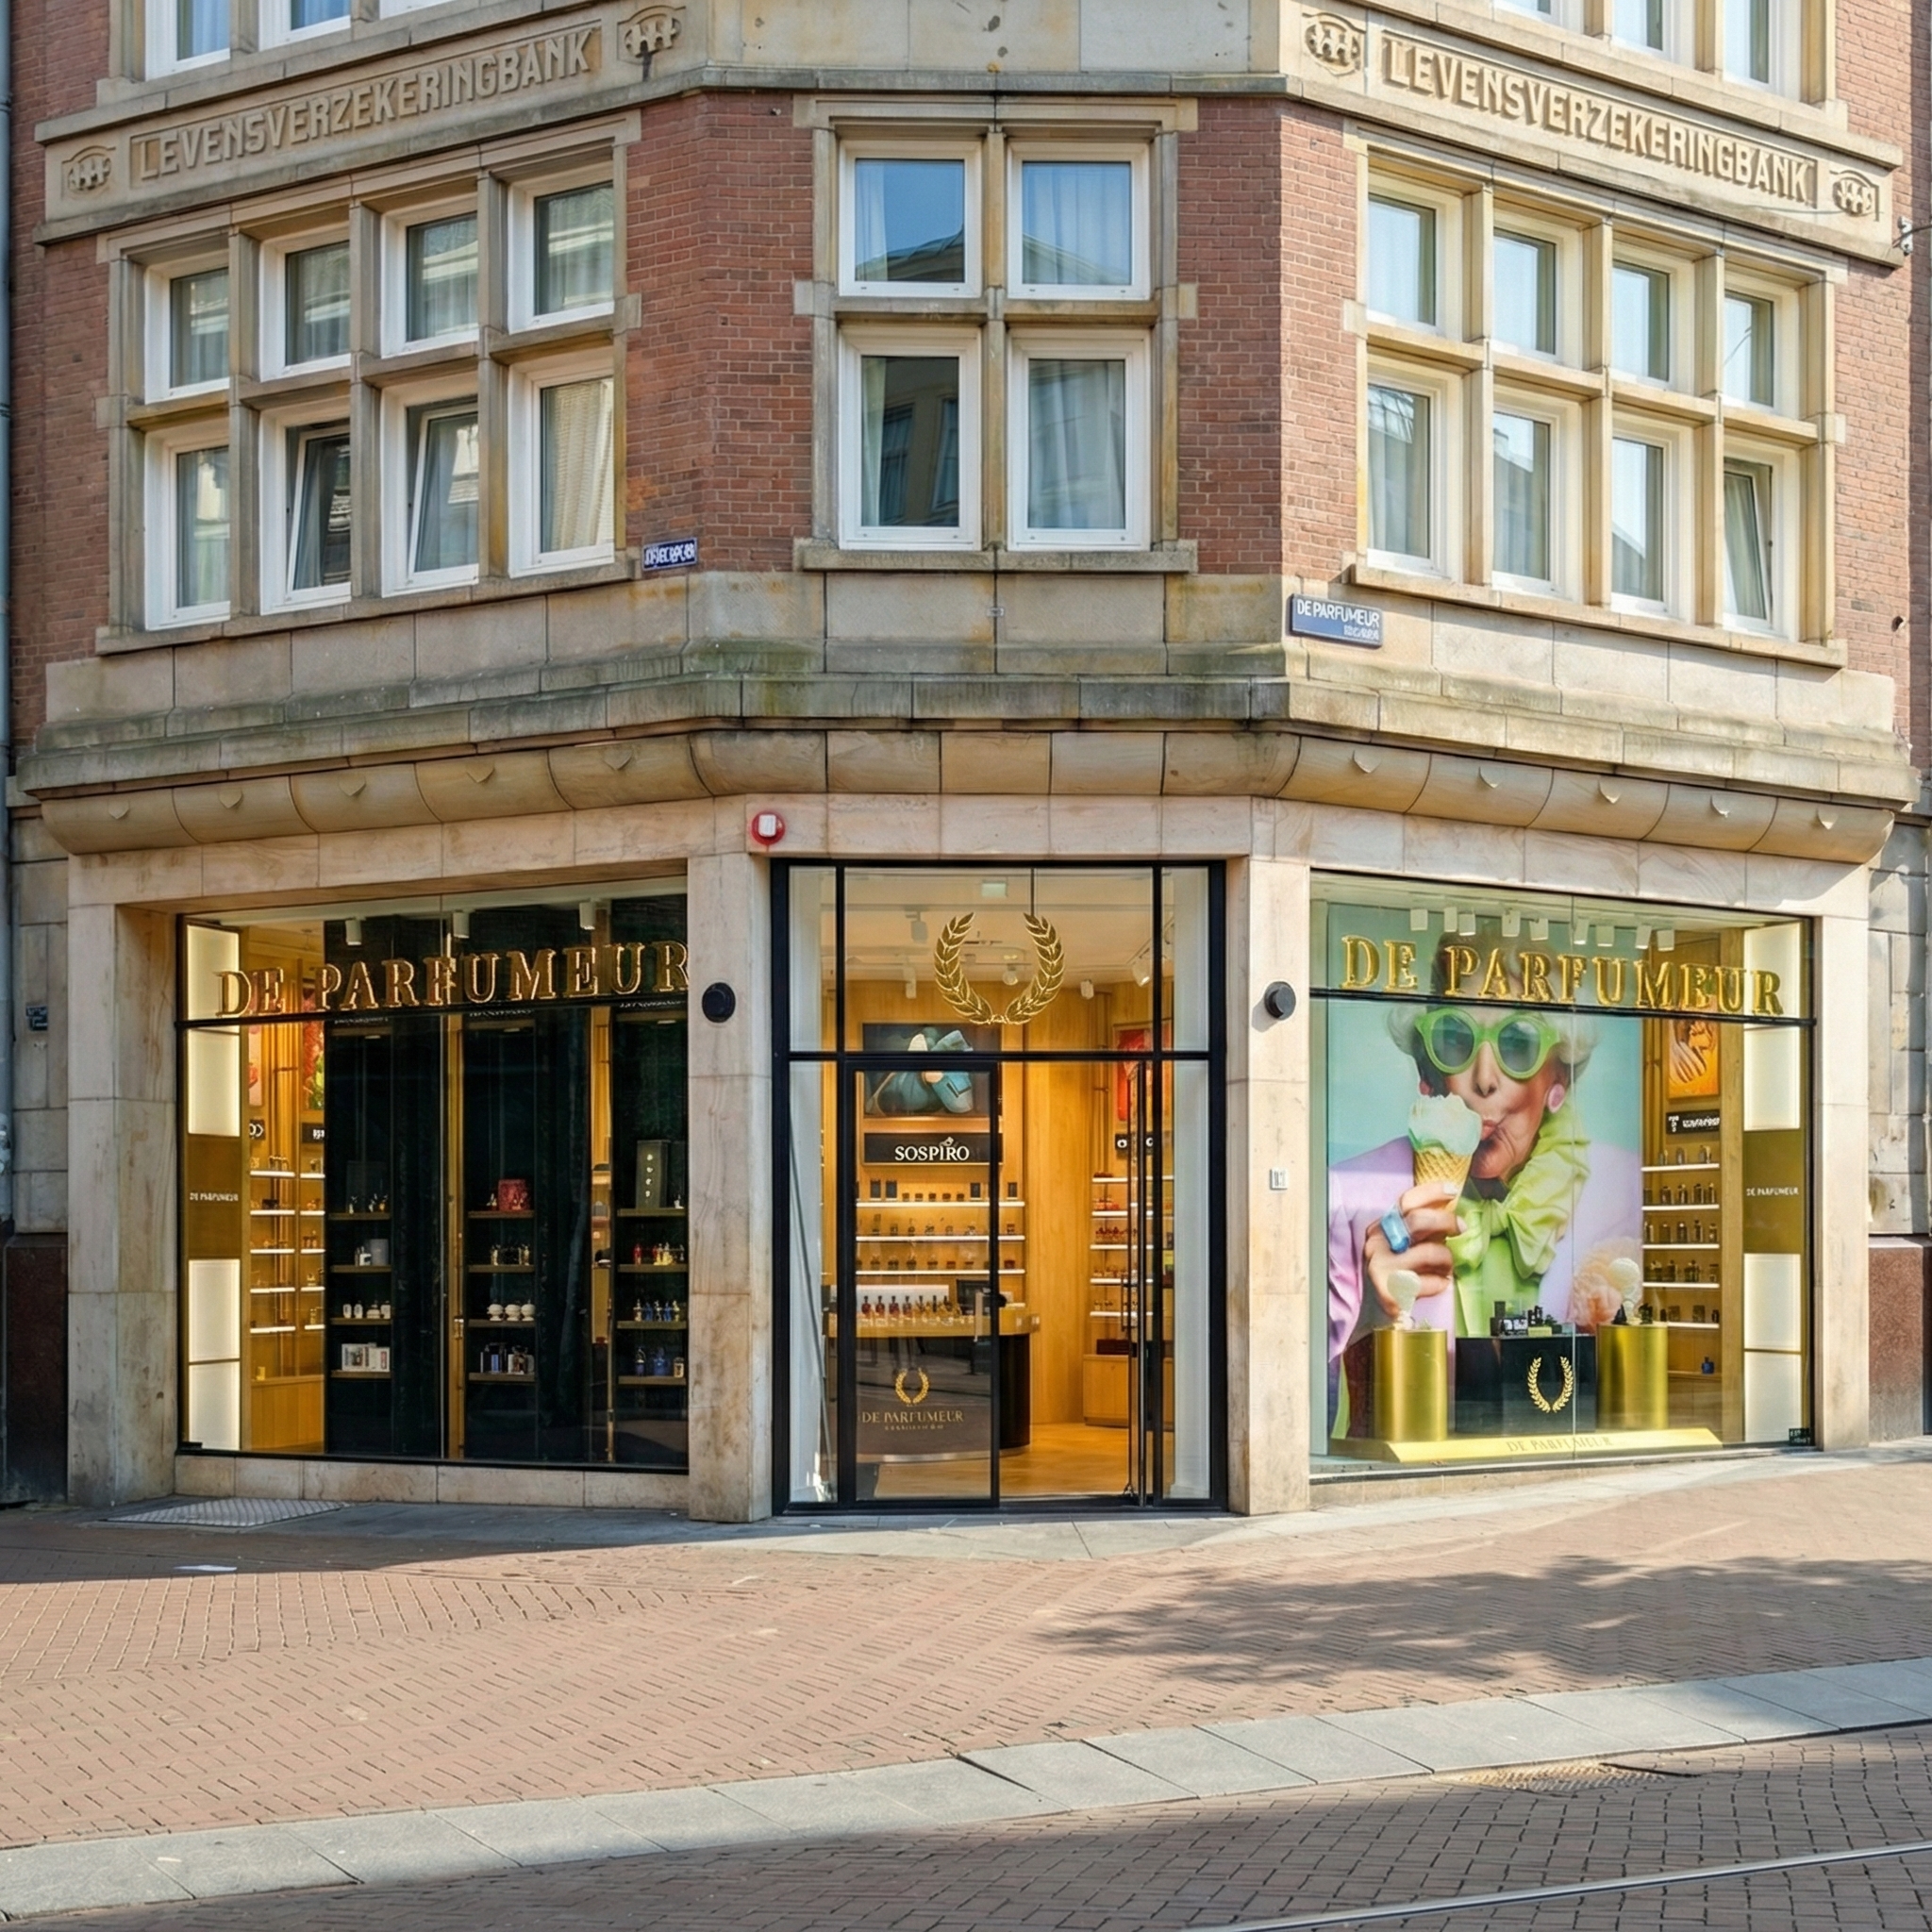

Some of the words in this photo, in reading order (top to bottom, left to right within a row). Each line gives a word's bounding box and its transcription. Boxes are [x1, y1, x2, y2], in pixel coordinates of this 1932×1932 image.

[138, 28, 592, 180] LEVENSVERZEKERINGBANK
[1383, 40, 1812, 203] LEVENSVERZEKERINGBANK
[1297, 599, 1312, 616] DE
[216, 967, 284, 1017] DE
[315, 941, 688, 1010] PARFUMEUR
[1341, 934, 1419, 991] DE
[1443, 944, 1785, 1016] PARFUMEUR
[894, 1145, 970, 1162] SOSPIRO
[862, 1411, 880, 1424] DE
